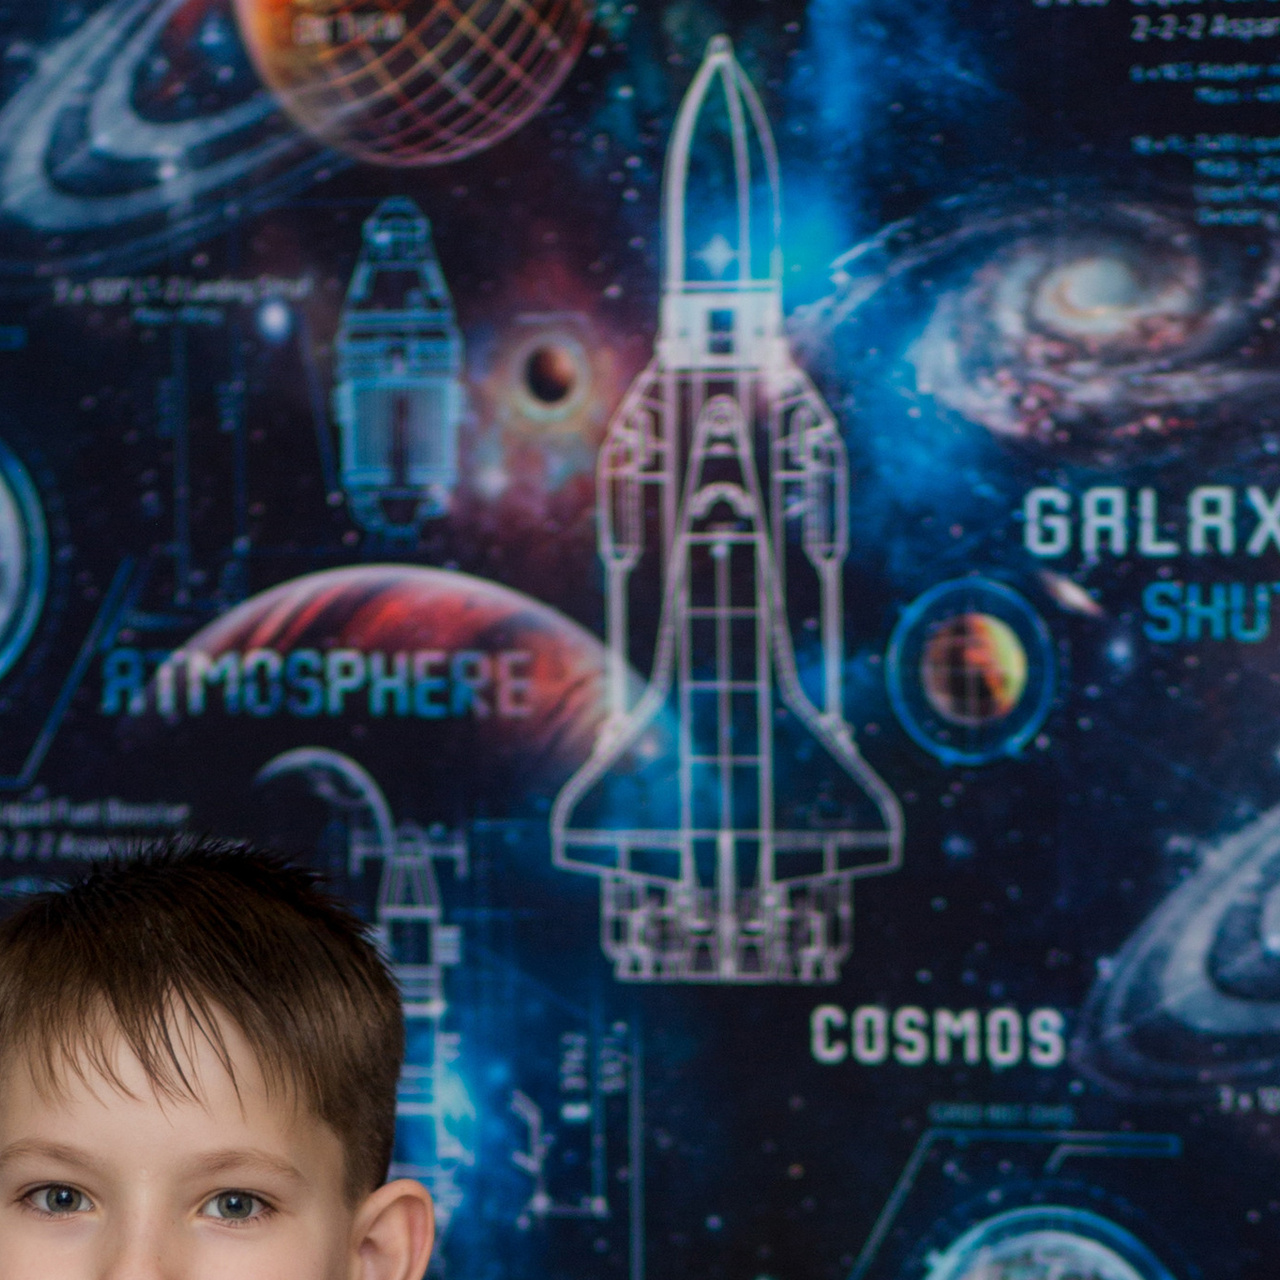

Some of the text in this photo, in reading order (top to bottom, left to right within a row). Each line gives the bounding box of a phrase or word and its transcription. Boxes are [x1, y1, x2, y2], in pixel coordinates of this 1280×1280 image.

[1024, 486, 1280, 558] GALAX
[1141, 581, 1280, 643] SHU
[100, 648, 533, 718] ATMOSPHERE
[810, 1004, 1068, 1067] COSMOS
